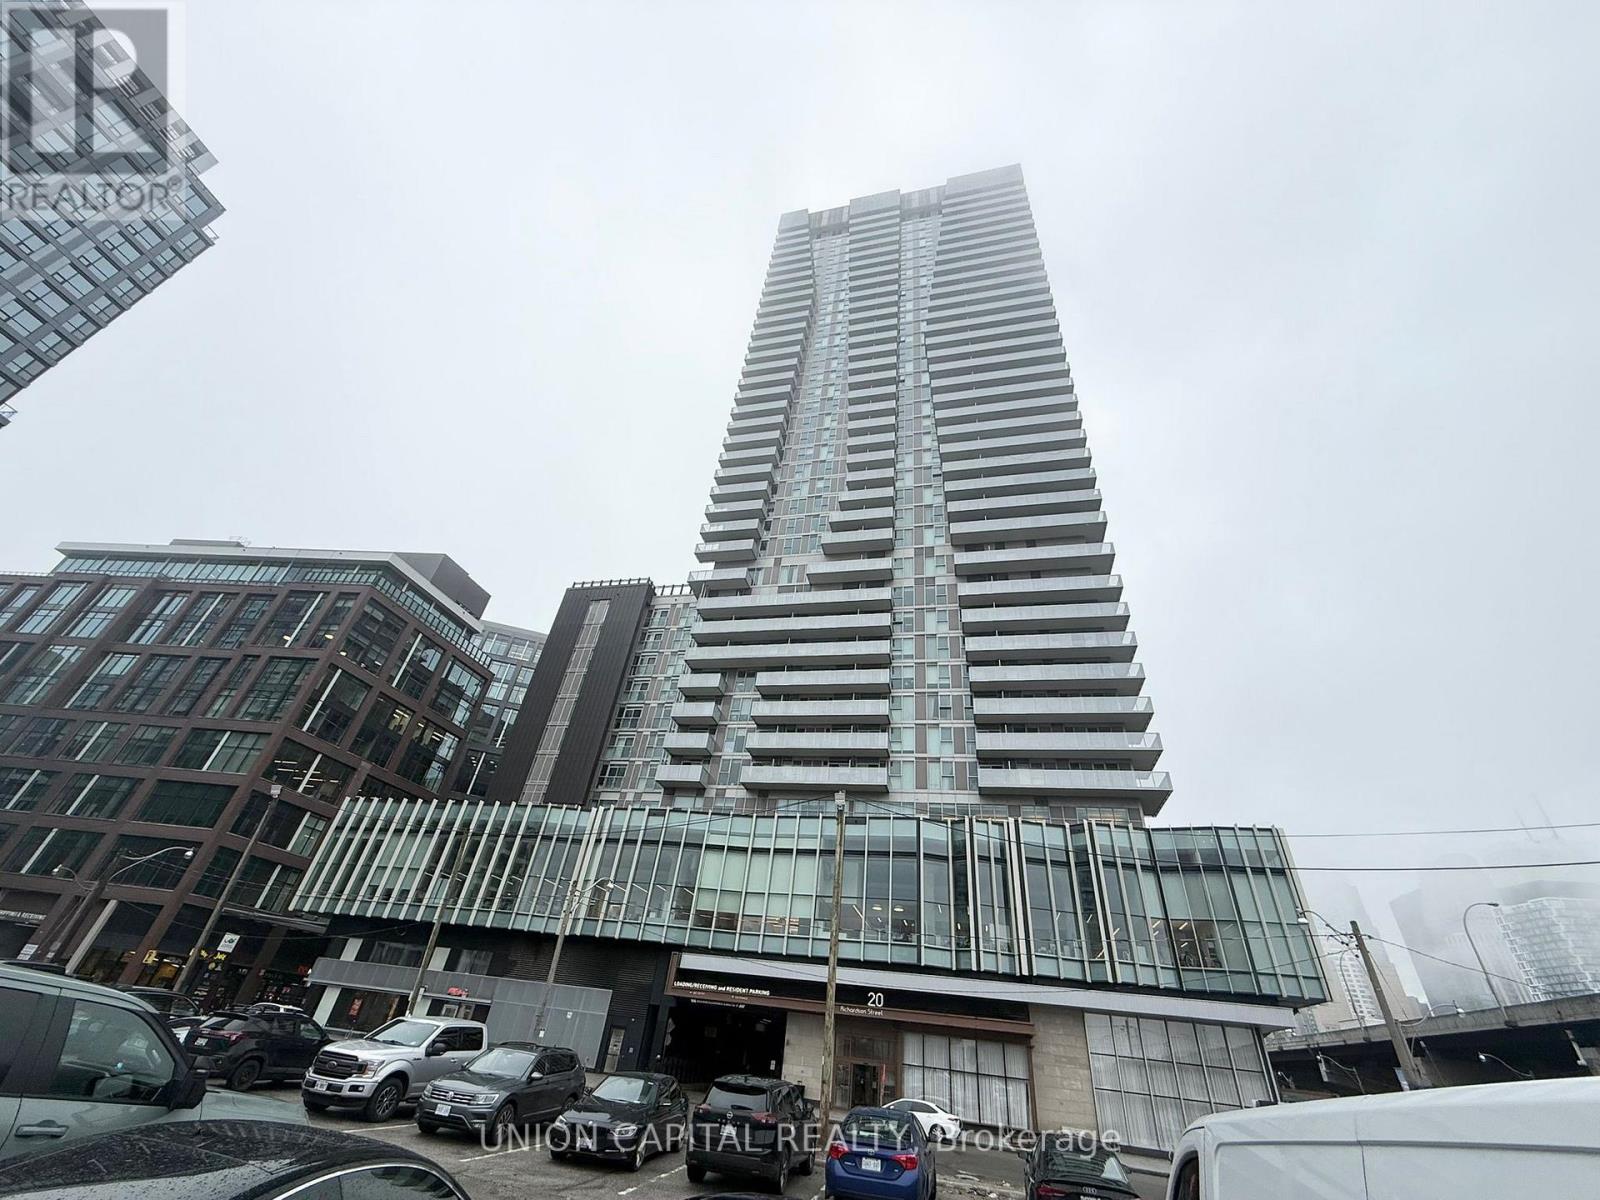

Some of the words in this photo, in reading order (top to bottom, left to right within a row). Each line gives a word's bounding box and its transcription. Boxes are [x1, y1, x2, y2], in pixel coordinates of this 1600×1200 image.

[726, 986, 749, 994] RESIDENT
[749, 988, 770, 996] PARKING
[867, 991, 884, 1007] 20
[840, 1005, 867, 1014] Richardson
[867, 1008, 883, 1016] Street
